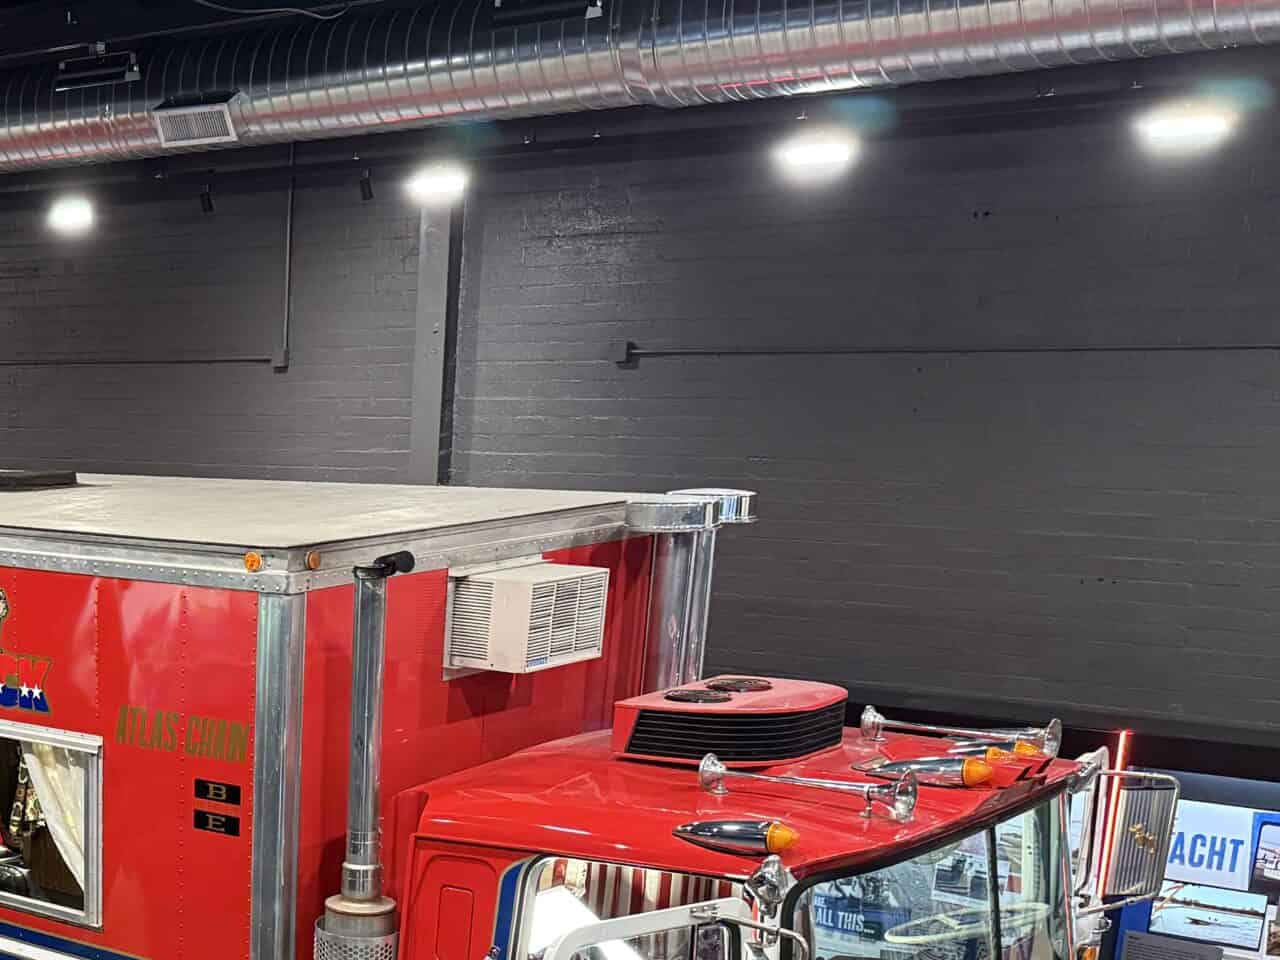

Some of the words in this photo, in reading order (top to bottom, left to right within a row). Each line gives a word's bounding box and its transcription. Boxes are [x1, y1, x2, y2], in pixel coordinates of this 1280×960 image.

[115, 703, 179, 752] ATLAS
[184, 715, 249, 763] CHAIN
[207, 783, 227, 800] B
[206, 814, 226, 832] E
[1168, 831, 1244, 872] ACHT
